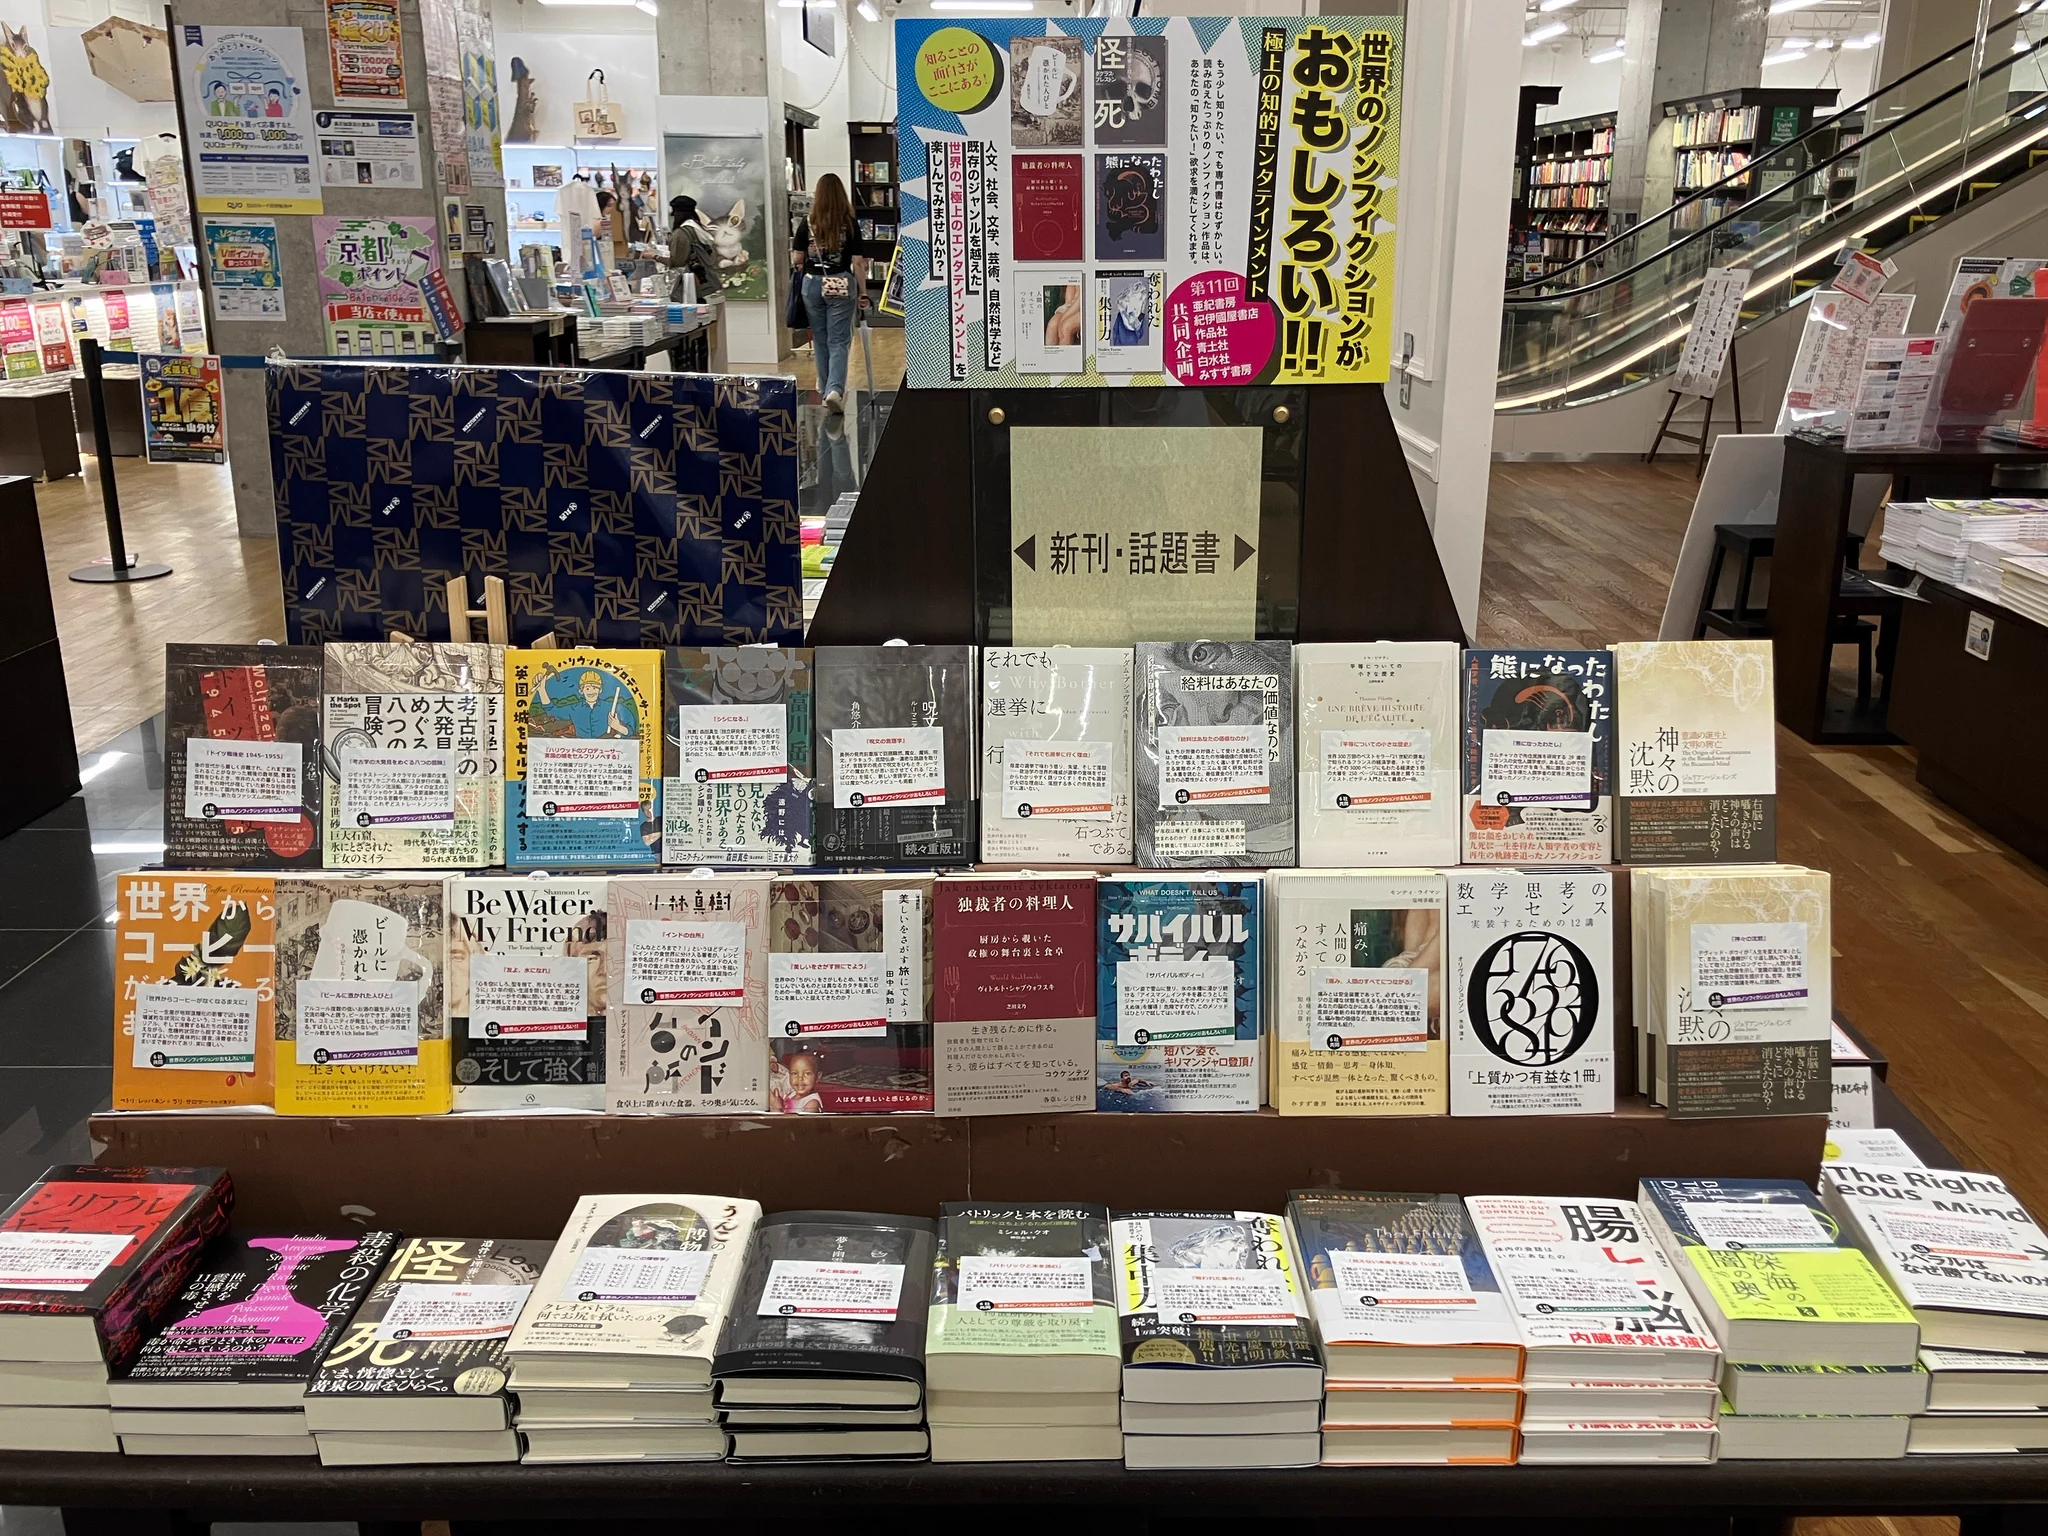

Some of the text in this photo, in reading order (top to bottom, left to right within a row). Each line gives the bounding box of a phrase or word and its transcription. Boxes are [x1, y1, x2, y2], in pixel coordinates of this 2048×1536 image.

[924, 42, 980, 66] 知ることの
[1094, 36, 1126, 70] 怪
[933, 60, 978, 80] 面白さが
[928, 74, 989, 98] ここにある!
[1094, 100, 1126, 129] 死
[1105, 156, 1162, 170] 熊になった
[1250, 32, 1284, 298] 極上の知的エンタテインメント
[1149, 168, 1164, 200] わたし
[930, 141, 946, 273] 楽しんでみませんか?
[1280, 30, 1353, 371] おもしろい!!
[1335, 34, 1389, 367] 世界のノンフィクションが
[966, 141, 983, 287] 既存のジャンルを越えた
[337, 234, 391, 265] 京都
[948, 142, 967, 375] 世界の「極上のエンタテインメント」を
[985, 141, 1001, 366] 人文、社会、文学、芸術、自然科学など
[357, 267, 404, 281] ポイント
[1190, 277, 1239, 297] 第11回
[1192, 297, 1236, 313] 亜紀書房
[1194, 308, 1259, 326] 紀伊國屋書店
[1098, 297, 1113, 342] 集中力
[1171, 303, 1194, 379] 共同企画
[1195, 326, 1228, 340] 作品社
[1196, 339, 1229, 354] 青土社
[1198, 353, 1230, 368] 白水社
[1199, 364, 1252, 381] みすず書房
[1050, 530, 1221, 575] 新刊・話題書
[986, 651, 1052, 668] それでも
[1489, 654, 1607, 679] 熊になった
[1008, 676, 1046, 692] Why
[1181, 676, 1278, 691] 給料はあなたの
[364, 696, 383, 735] 冒険
[987, 698, 1047, 717] 選挙に
[1349, 703, 1379, 712] BRÈVE
[1381, 704, 1425, 712] HISTOIRE
[1582, 680, 1610, 742] わたし
[457, 695, 478, 776] 考古学の
[1264, 691, 1279, 762] 価値なのか
[1681, 731, 1727, 740] 意識の誕生と
[1629, 742, 1654, 794] 沈黙
[1655, 727, 1680, 794] 神々の
[1721, 800, 1730, 828] どこに
[1730, 799, 1740, 848] 神々の声は
[1741, 799, 1751, 850] 囁きかける
[1709, 800, 1720, 858] 消えたのか?
[330, 843, 393, 852] 氷にとざされた
[905, 842, 961, 855] 続々重版!!
[1089, 842, 1132, 856] である。
[125, 882, 275, 922] 世界から
[466, 889, 597, 917] Be Water,
[650, 889, 732, 915] 小林真樹
[1457, 882, 1607, 900] 数学思考の
[957, 894, 1074, 913] 独裁者の料理人
[1456, 902, 1608, 917] エッセンス
[457, 917, 606, 951] My Friend
[979, 933, 1052, 944] 厨房から覗いた
[1108, 910, 1249, 943] サバイバル
[124, 931, 275, 964] コーヒー
[374, 917, 388, 971] ビールに
[1296, 924, 1308, 976] つながる
[1334, 923, 1347, 964] 人間の
[1353, 922, 1369, 958] 痛み、
[898, 893, 910, 1018] 美しいをさがす旅にでよう
[968, 947, 1064, 958] 政権の舞台裏と食卓
[971, 1025, 1058, 1035] 生き残るために作る。
[481, 1057, 584, 1082] そして強く
[946, 1059, 1079, 1072] そう、彼らはすべてを知っている。
[1045, 1069, 1091, 1078] コウケンテツ
[1164, 1056, 1254, 1067] キリマンジャロ登頂!
[1774, 1046, 1783, 1078] どこに
[1783, 1047, 1795, 1099] 神々の声は
[1467, 1069, 1601, 1085] 「上質かつ有益な1冊」
[835, 1094, 930, 1103] 人はなぜ美しいと感じるのか。
[1825, 1166, 1901, 1186] The
[20, 1194, 176, 1216] シリアル
[957, 1209, 1090, 1221] パトリックと本を読む
[1835, 1182, 2032, 1224] eous Mind
[710, 1205, 740, 1251] うんこの
[1560, 1205, 1640, 1243] 腸
[291, 1234, 327, 1242] Insulin
[267, 1262, 311, 1272] Aconite
[387, 1239, 472, 1281] 怪
[1892, 1252, 1988, 1271] リベラルは
[316, 1231, 393, 1321] 毒殺の化学
[224, 1314, 280, 1323] Polonium
[231, 1303, 289, 1313] Potassium
[536, 1312, 666, 1322] 何でお尻を拭いたのか?
[543, 1303, 630, 1315] クレオパトラは、
[956, 1317, 1093, 1327] 人としての尊厳を取り戻す
[1570, 1332, 1719, 1351] 内臓感覚は強し
[310, 1379, 449, 1393] 黄泉の扉をひらく。
[318, 1368, 440, 1380] いま、恍惚として
